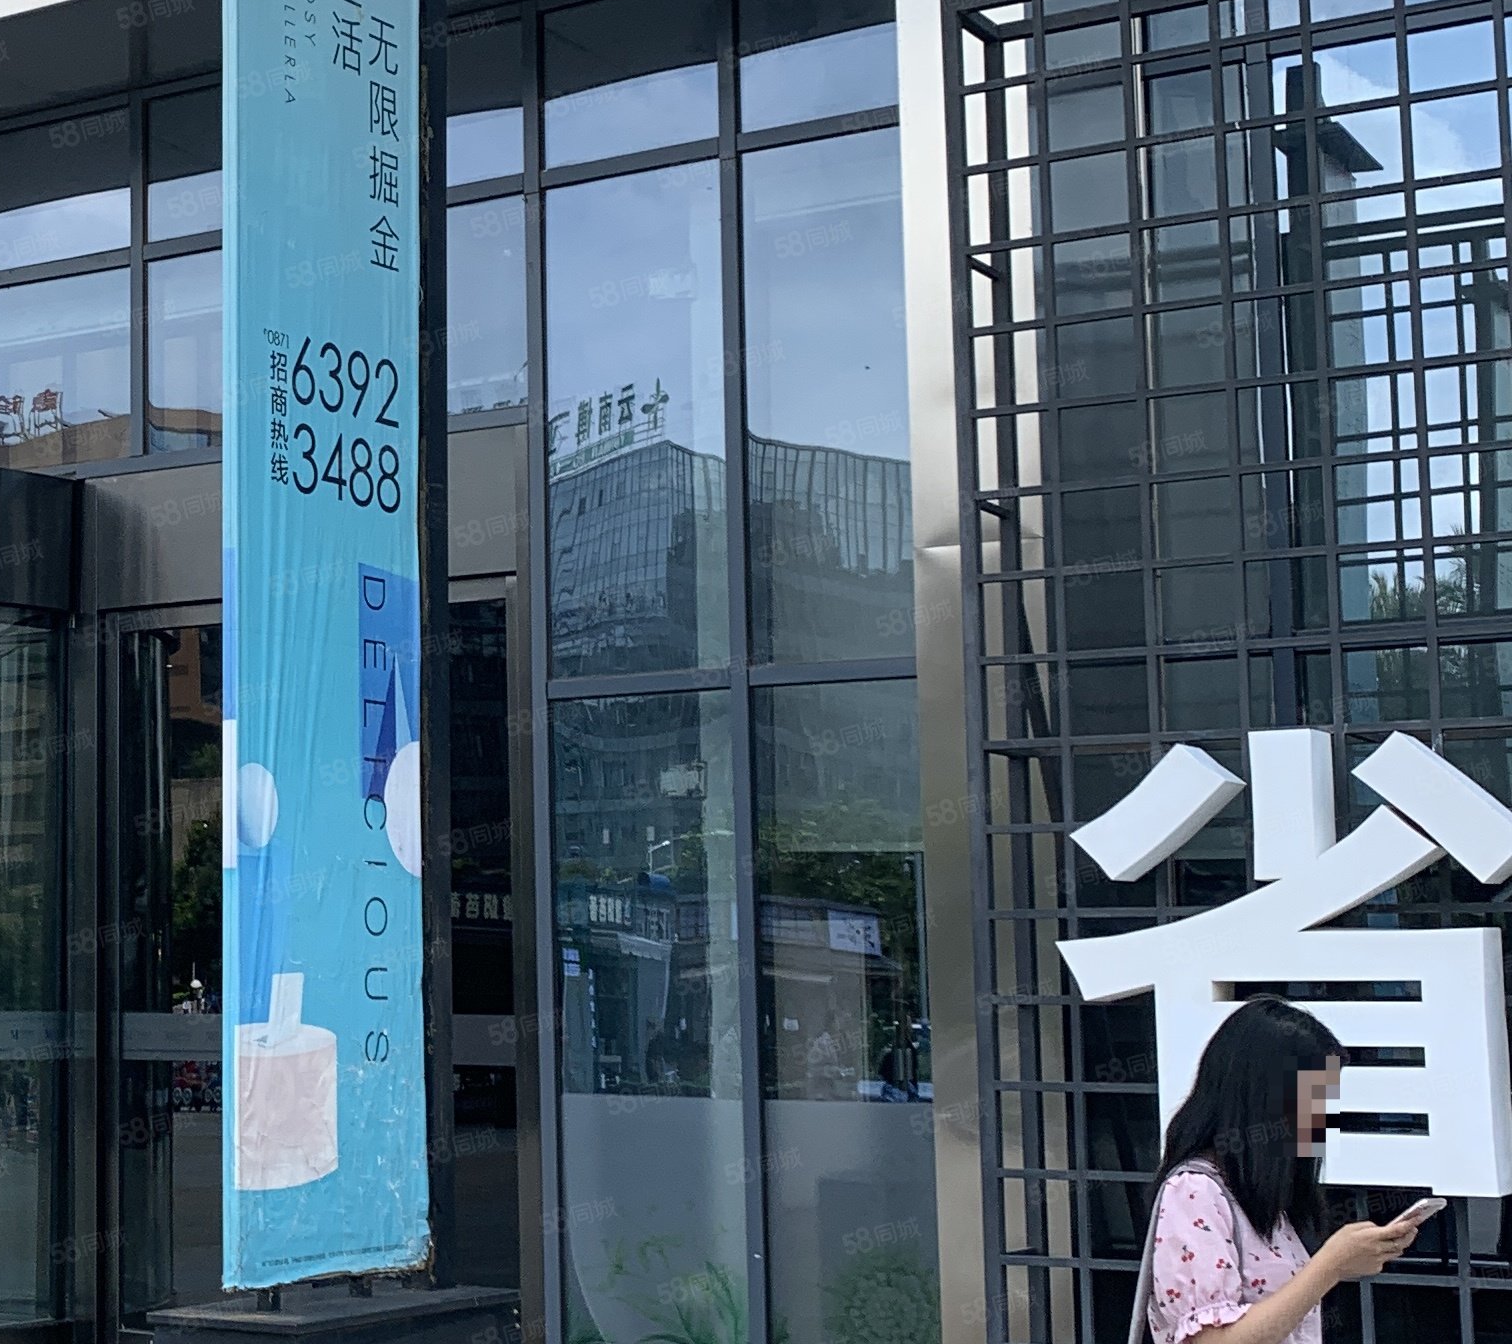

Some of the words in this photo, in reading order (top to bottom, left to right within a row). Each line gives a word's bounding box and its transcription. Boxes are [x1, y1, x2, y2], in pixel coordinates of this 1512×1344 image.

[368, 15, 400, 273] 无限掘金
[269, 350, 290, 485] 招商热线
[291, 335, 400, 430] 6392
[292, 423, 402, 514] 3488
[362, 575, 389, 1063] DELICIOUS
